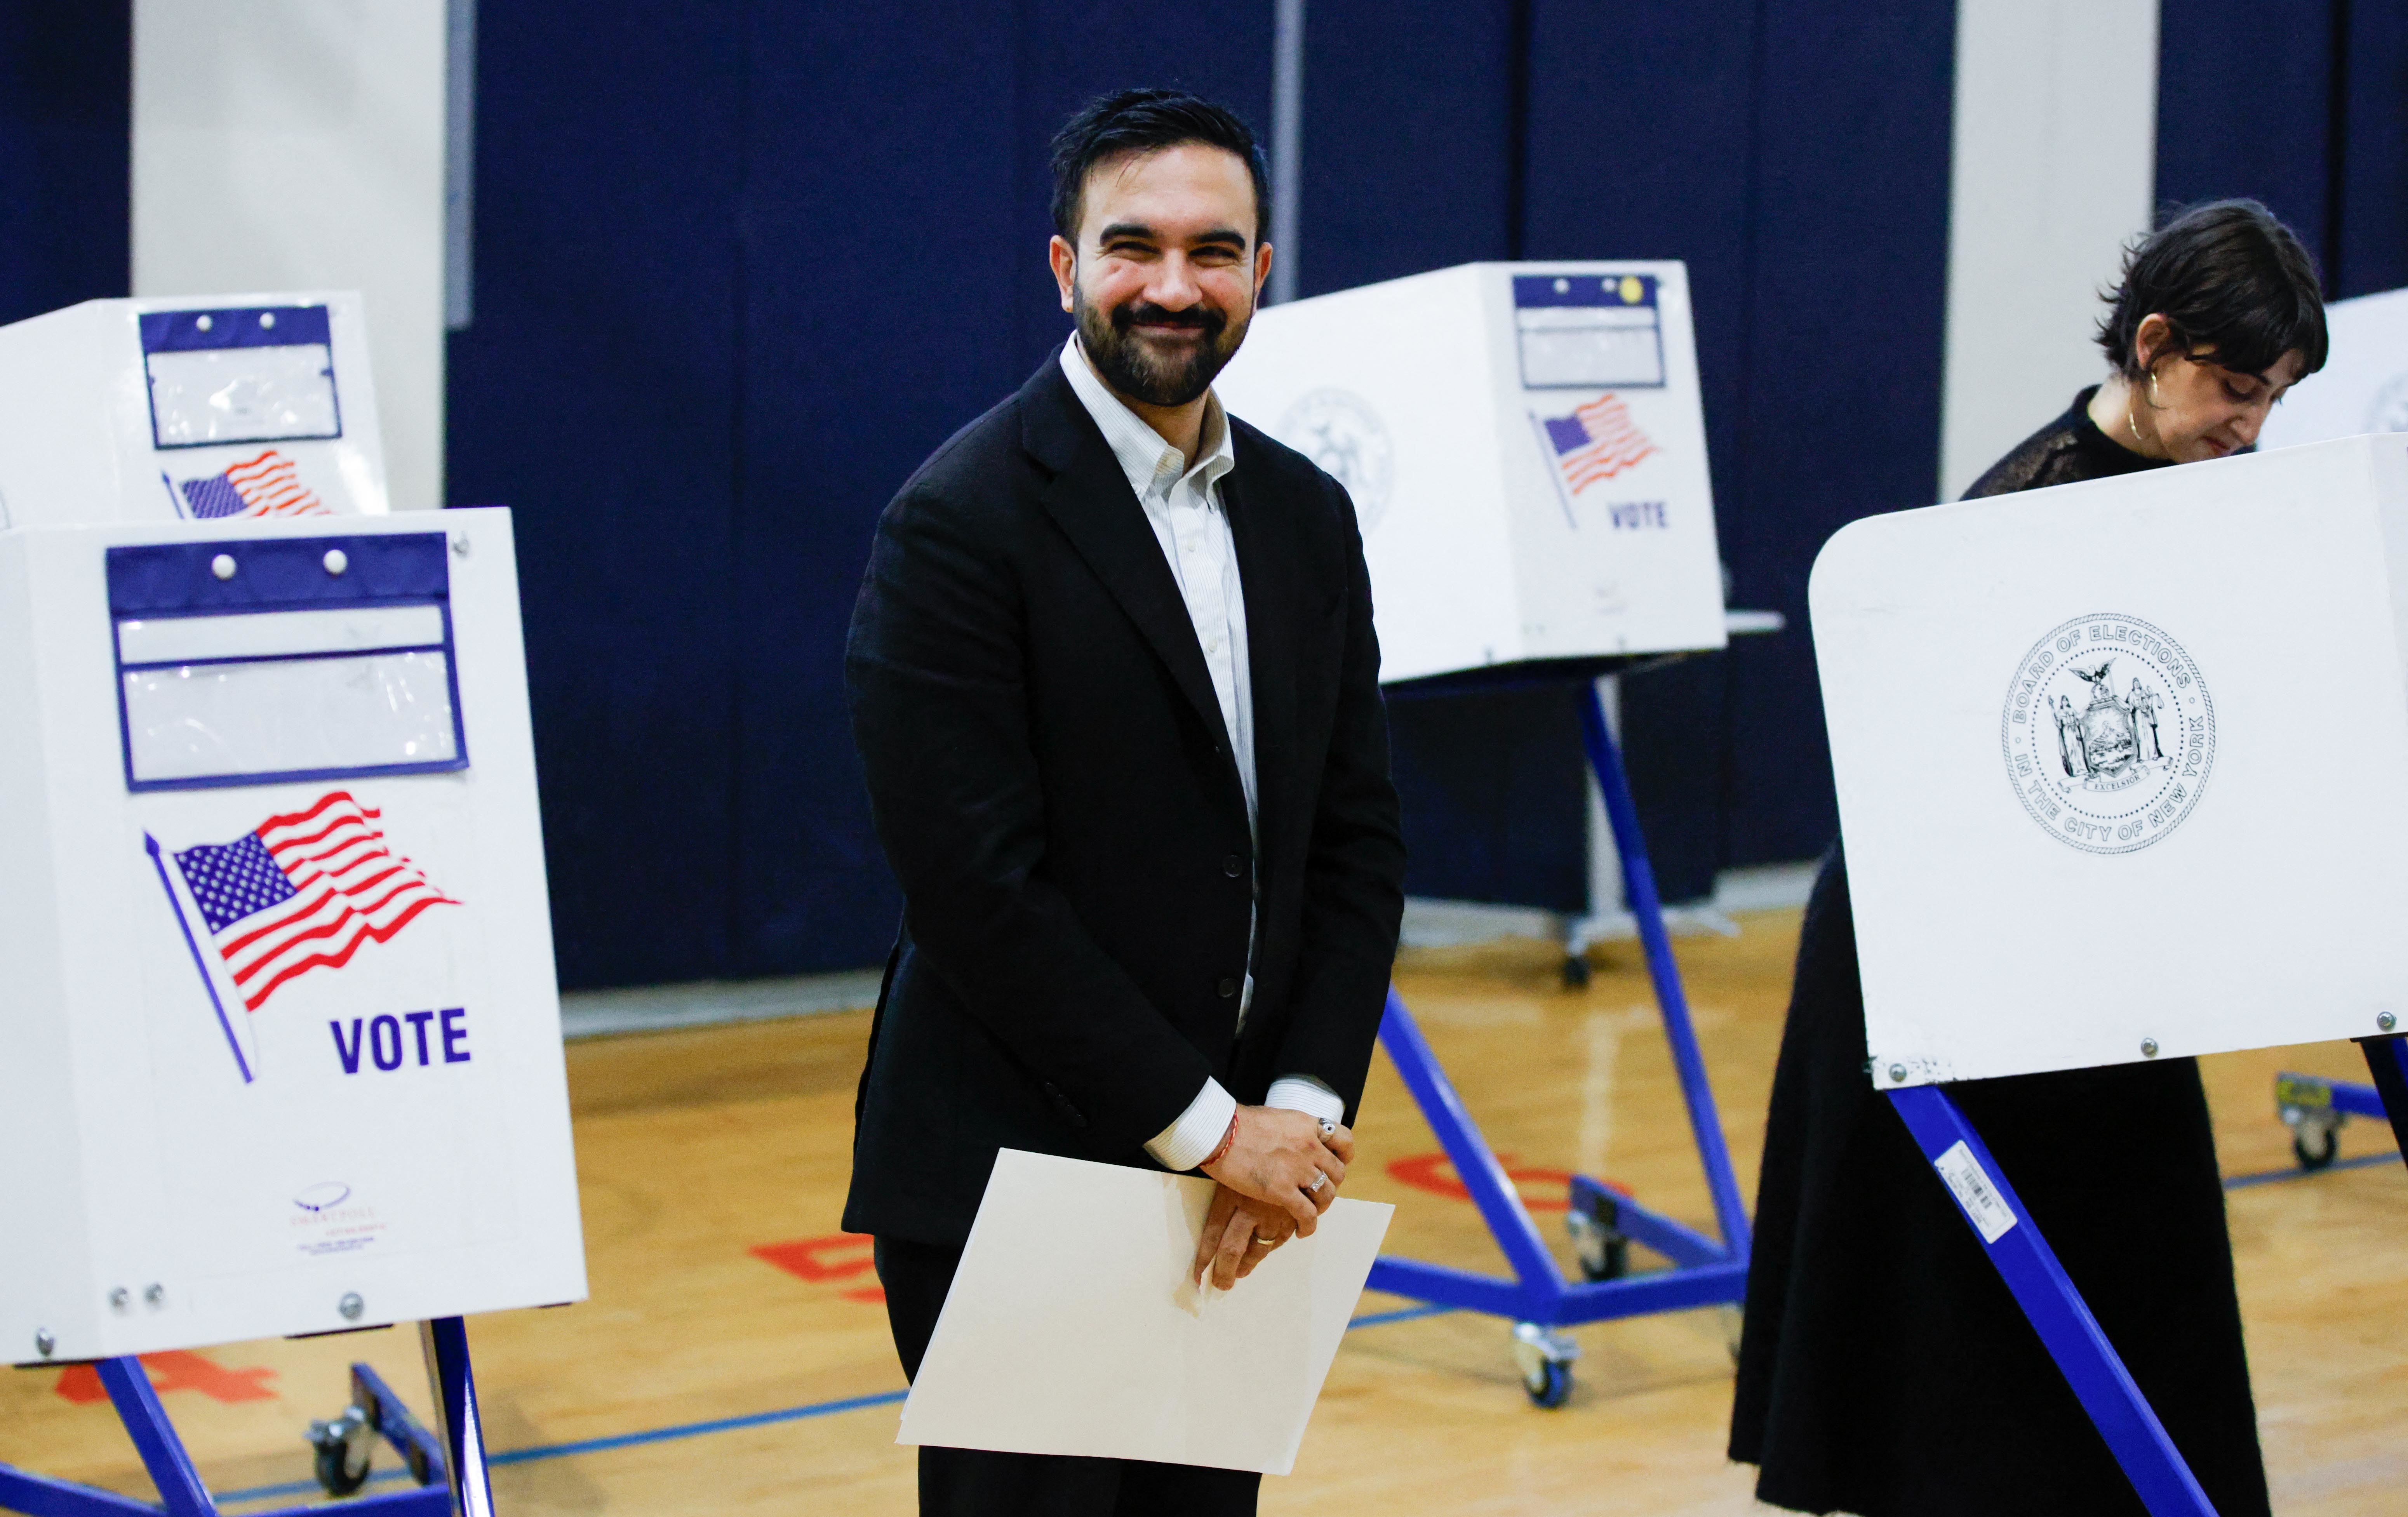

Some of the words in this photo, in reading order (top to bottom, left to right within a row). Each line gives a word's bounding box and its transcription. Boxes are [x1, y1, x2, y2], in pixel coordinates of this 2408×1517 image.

[1609, 501, 1668, 529] VOTE
[2013, 651, 2053, 724] BOARD
[2057, 630, 2081, 652] OF
[2090, 626, 2191, 688] ELECTIONS
[2015, 753, 2032, 777] IN
[2028, 780, 2061, 820] THE
[2065, 817, 2112, 841] CITY
[2118, 820, 2144, 840] OF
[2148, 783, 2187, 828] NEW
[2182, 715, 2203, 778] YORK
[2095, 774, 2140, 790] EXCELSIOR
[329, 1008, 470, 1074] VOTE
